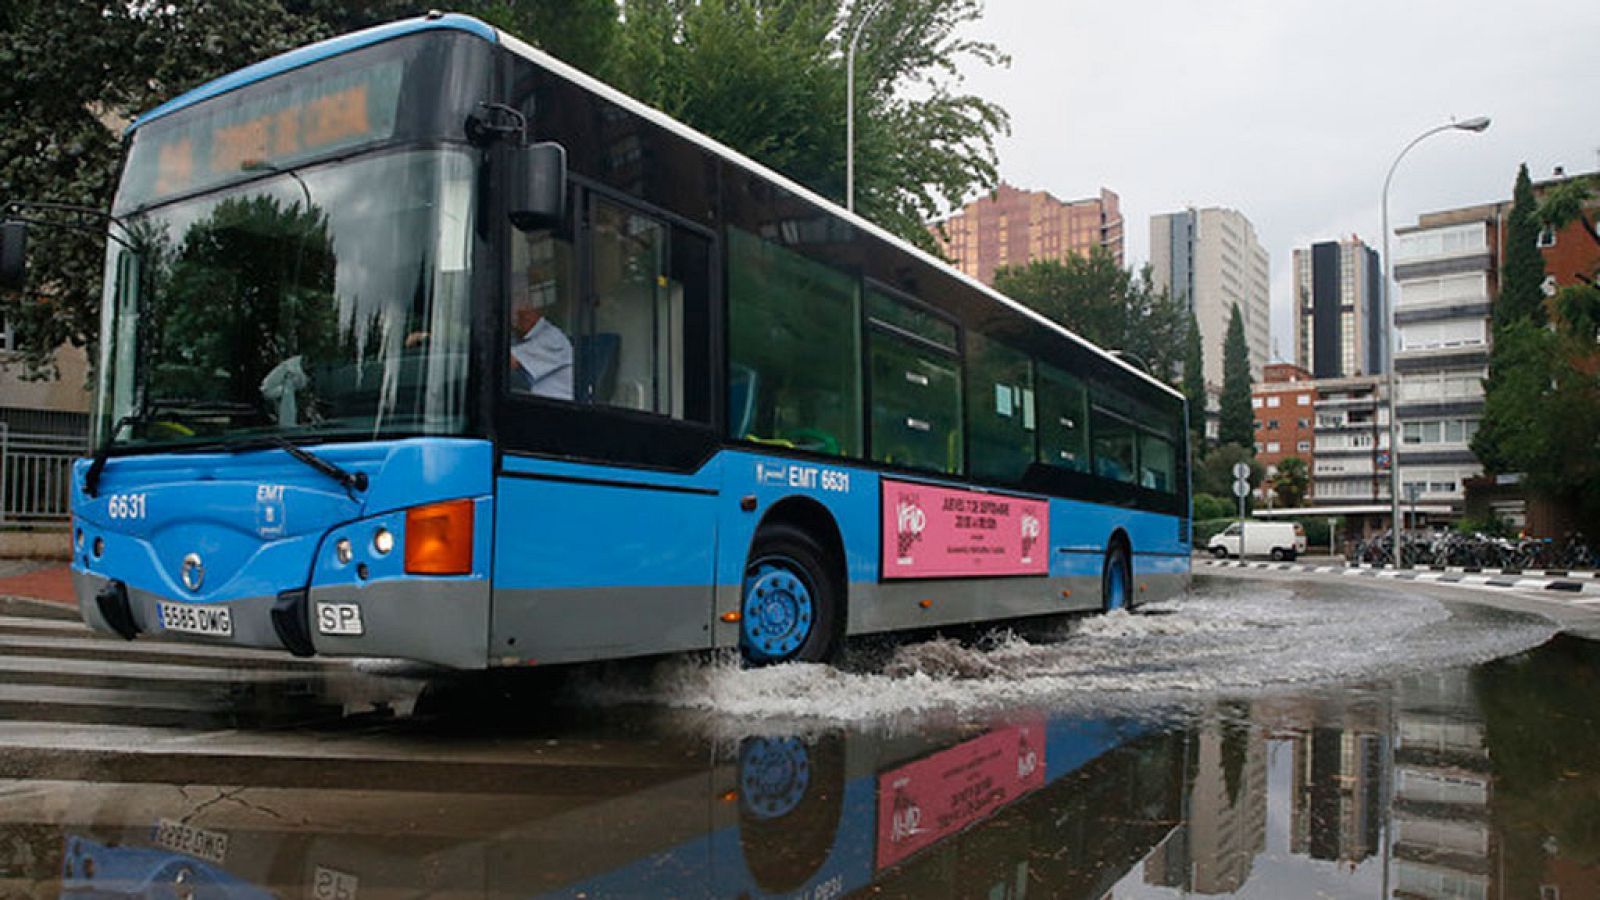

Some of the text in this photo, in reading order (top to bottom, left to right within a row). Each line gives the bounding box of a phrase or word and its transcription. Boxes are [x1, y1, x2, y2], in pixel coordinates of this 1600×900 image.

[789, 465, 849, 493] EMT 6631
[108, 493, 147, 520] 6631
[256, 485, 285, 502] EMT
[164, 605, 229, 632] 5585 DWG
[322, 606, 355, 630] SP
